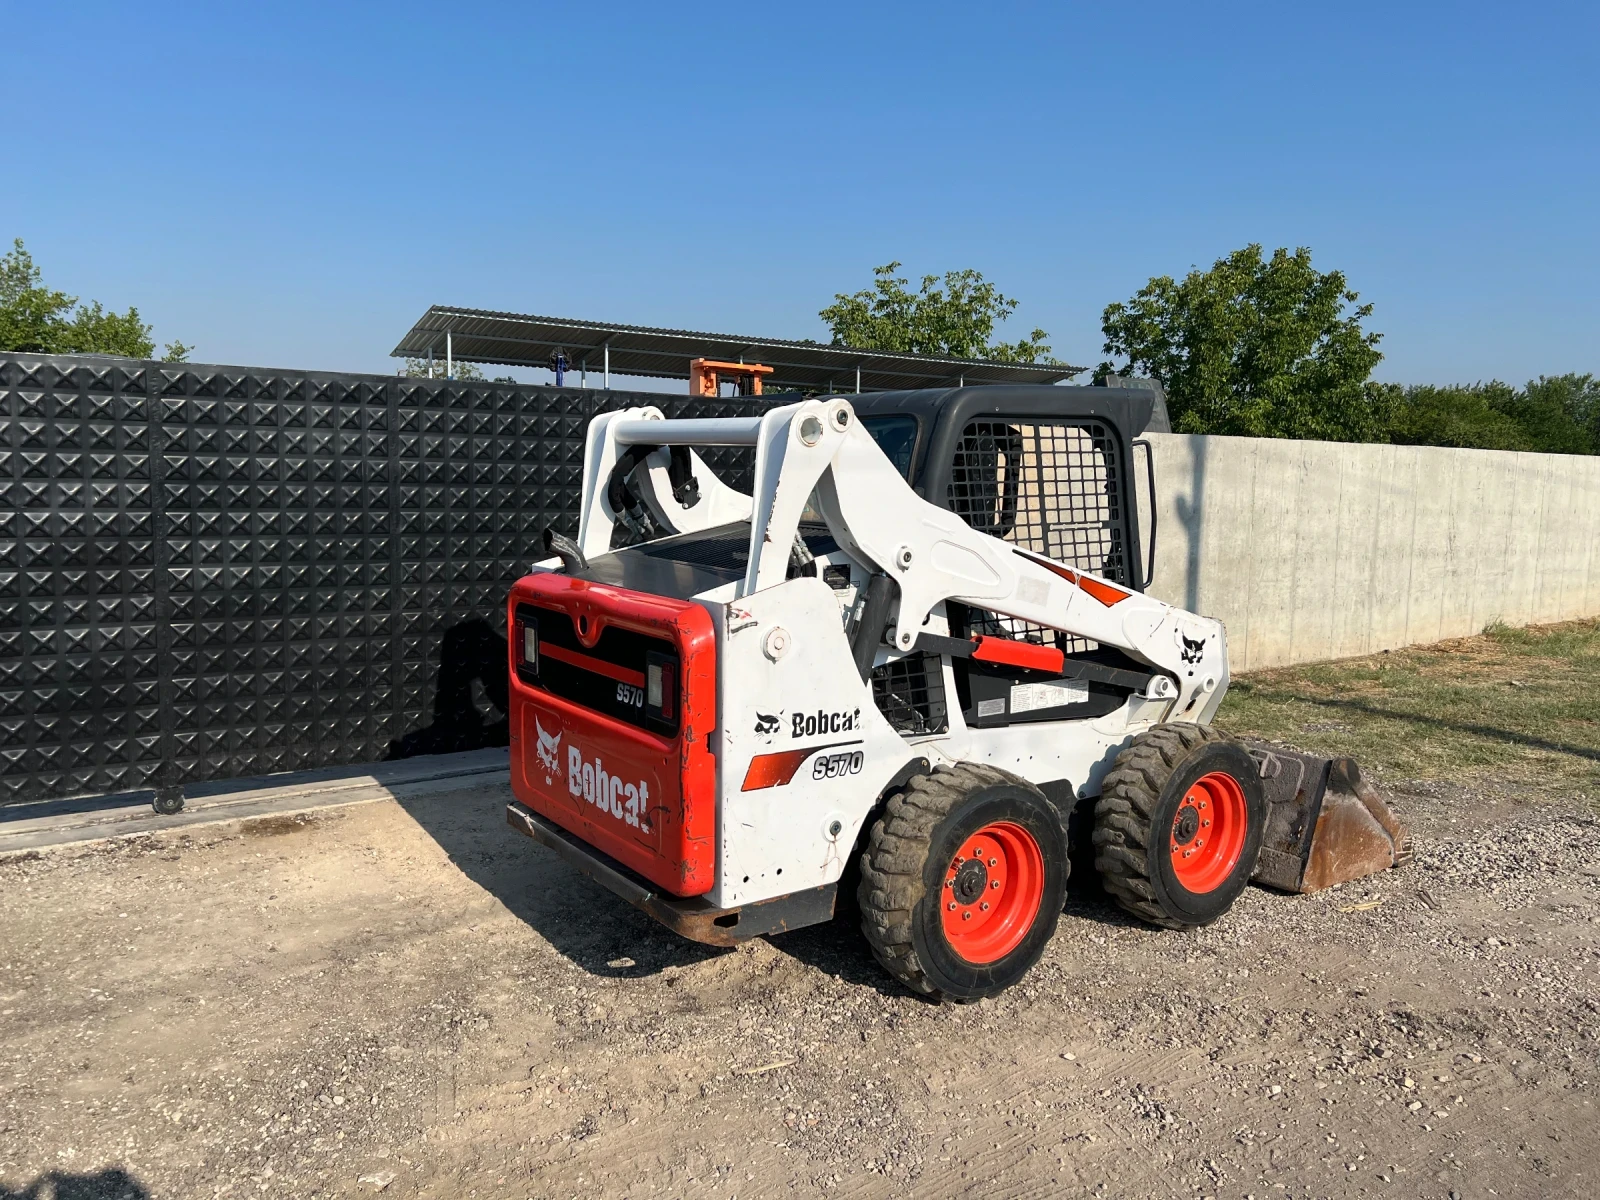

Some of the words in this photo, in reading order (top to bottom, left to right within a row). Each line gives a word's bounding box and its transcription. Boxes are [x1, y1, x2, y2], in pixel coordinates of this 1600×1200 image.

[616, 683, 644, 708] S570
[812, 750, 864, 781] S570
[567, 744, 649, 835] Bobcat
